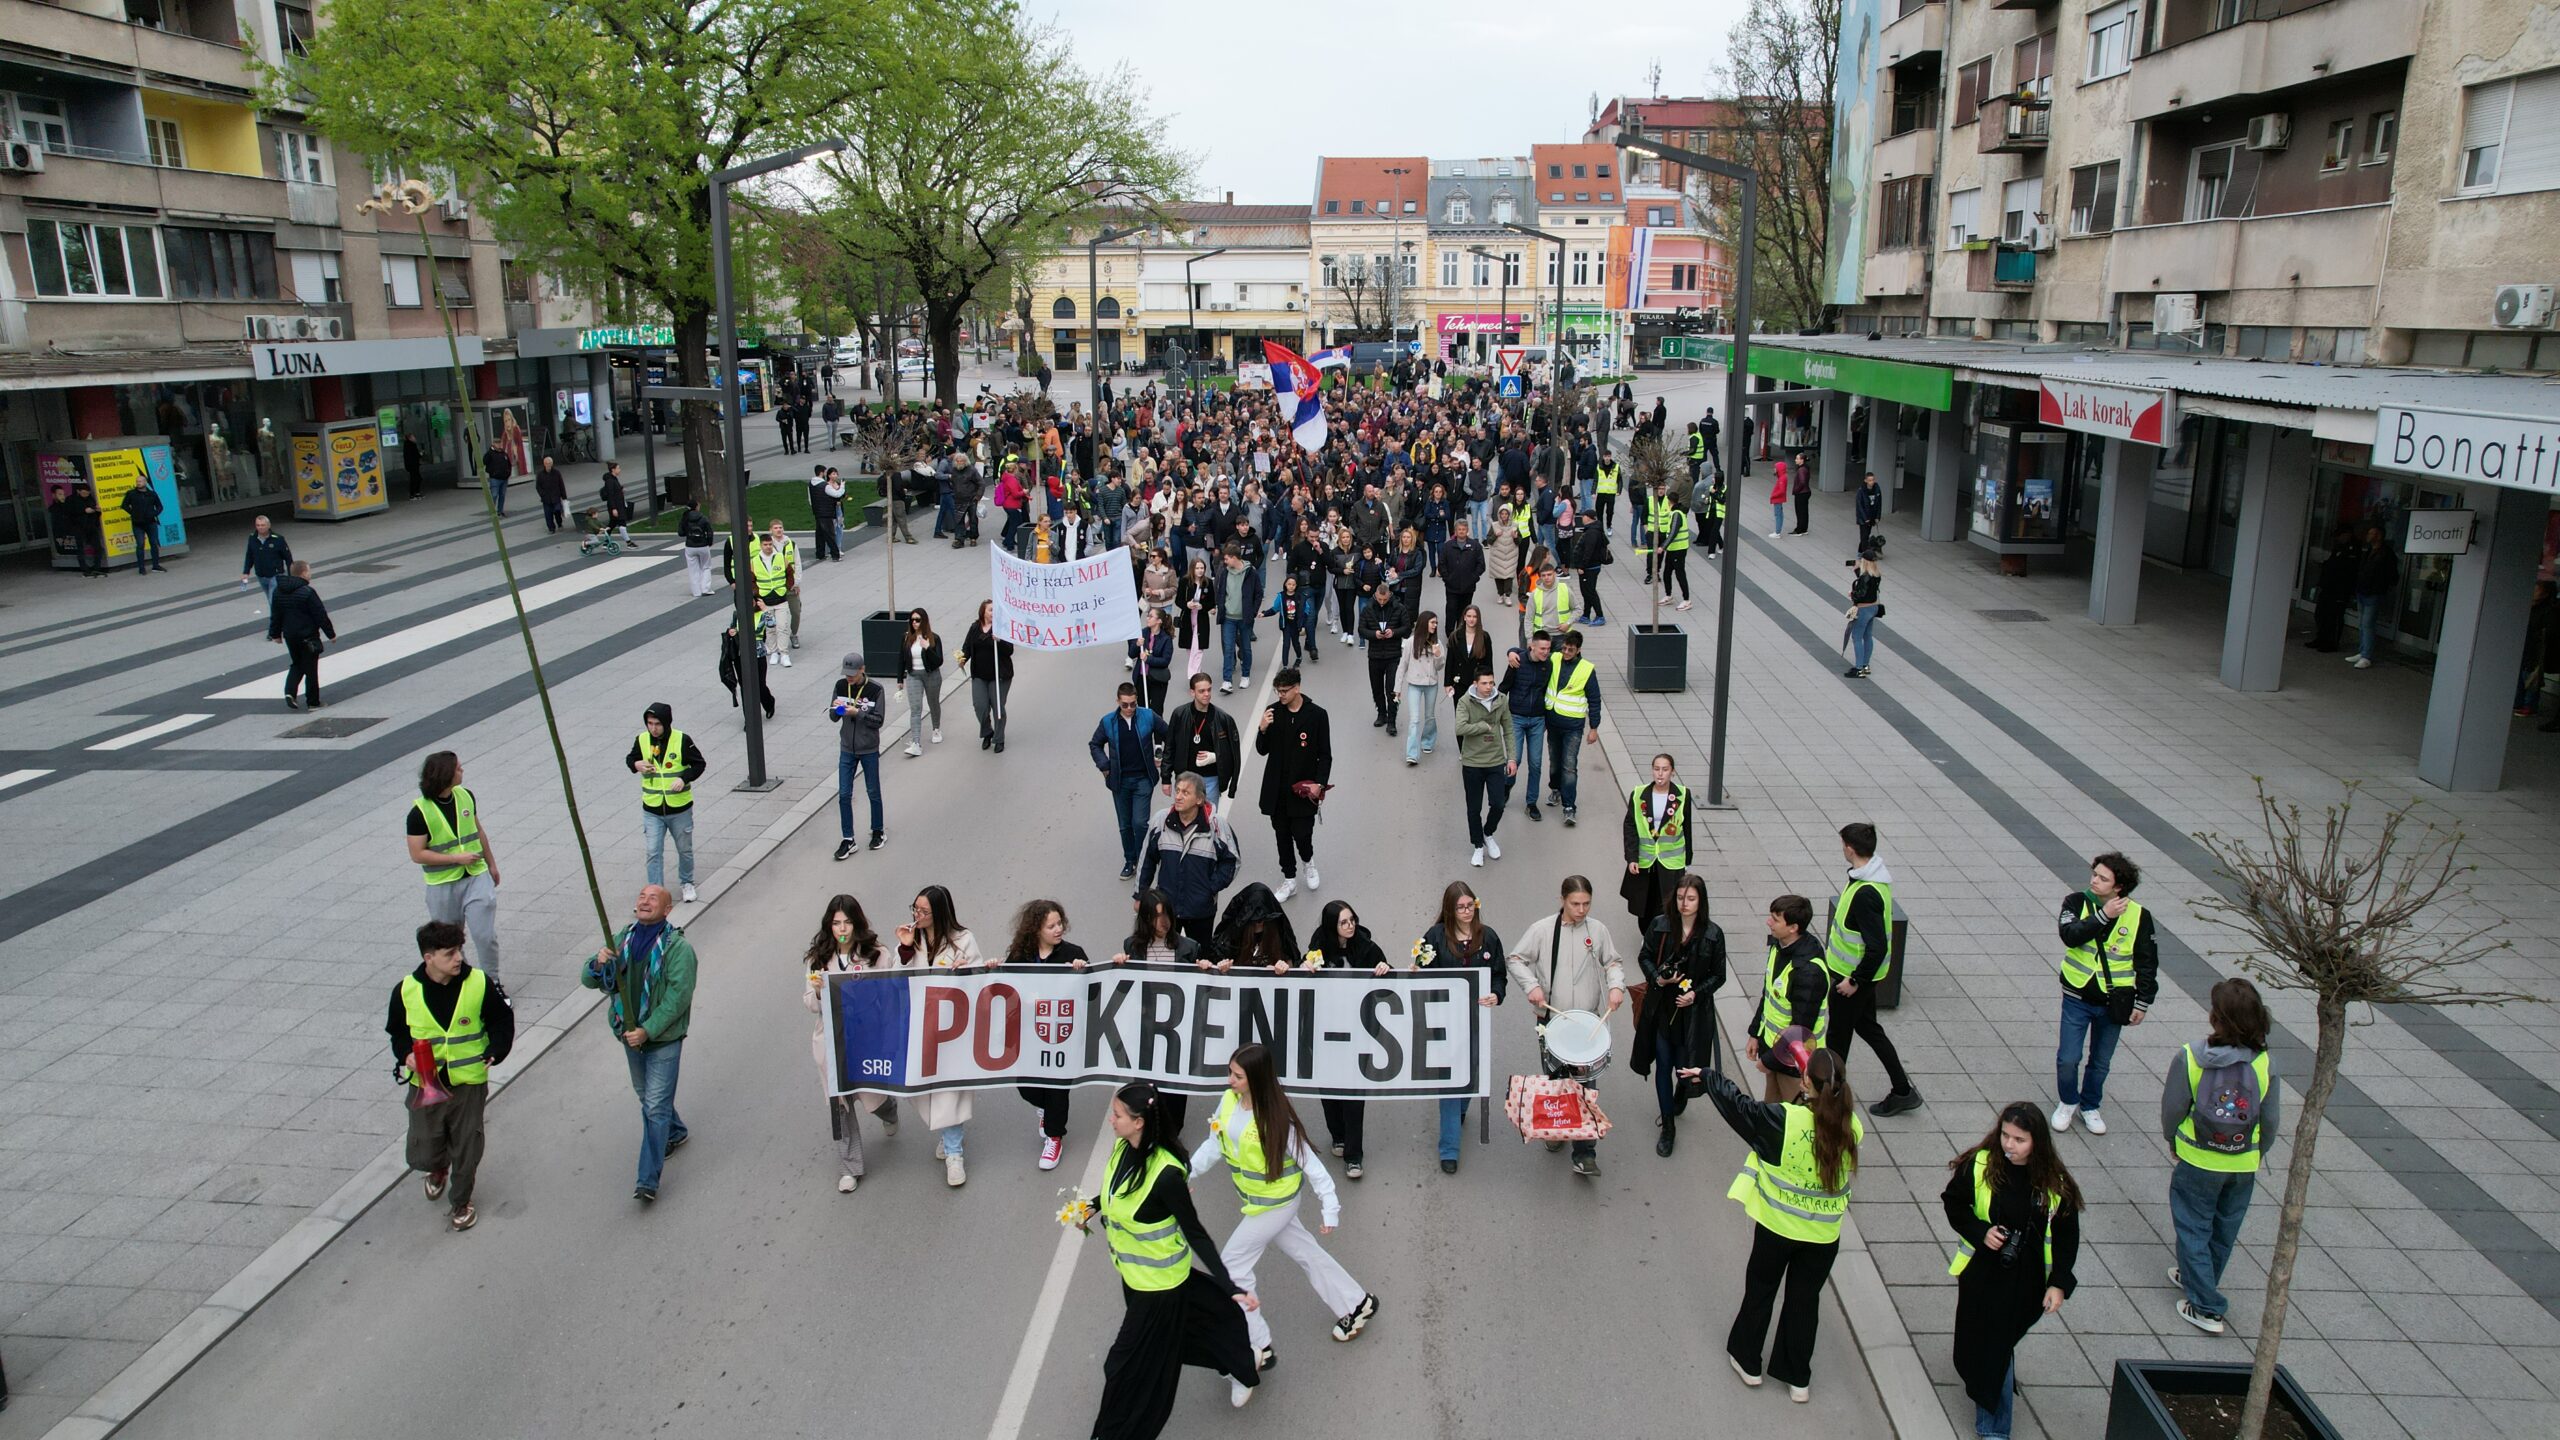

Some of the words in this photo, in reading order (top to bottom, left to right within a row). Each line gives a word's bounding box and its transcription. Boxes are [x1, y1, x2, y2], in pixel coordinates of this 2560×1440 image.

[1639, 313, 1665, 321] PEKARA
[581, 328, 639, 350] APOTEKA
[266, 348, 327, 376] LUNA
[2063, 391, 2088, 420] Lak
[2092, 395, 2133, 428] korak
[2393, 410, 2560, 488] Bonatti
[2411, 524, 2465, 541] Bonatti
[1026, 572, 1039, 588] је
[1044, 577, 1074, 587] кад
[1077, 560, 1110, 584] МИ
[1003, 587, 1066, 614] Кажемо
[1070, 601, 1089, 614] да
[1093, 595, 1106, 611] је
[1010, 619, 1098, 647] КРАЈ!!!
[921, 982, 1022, 1078] PO
[1084, 979, 1452, 1082] KRENI-SE
[862, 1058, 893, 1077] SRB
[2207, 1141, 2246, 1152] adidas
